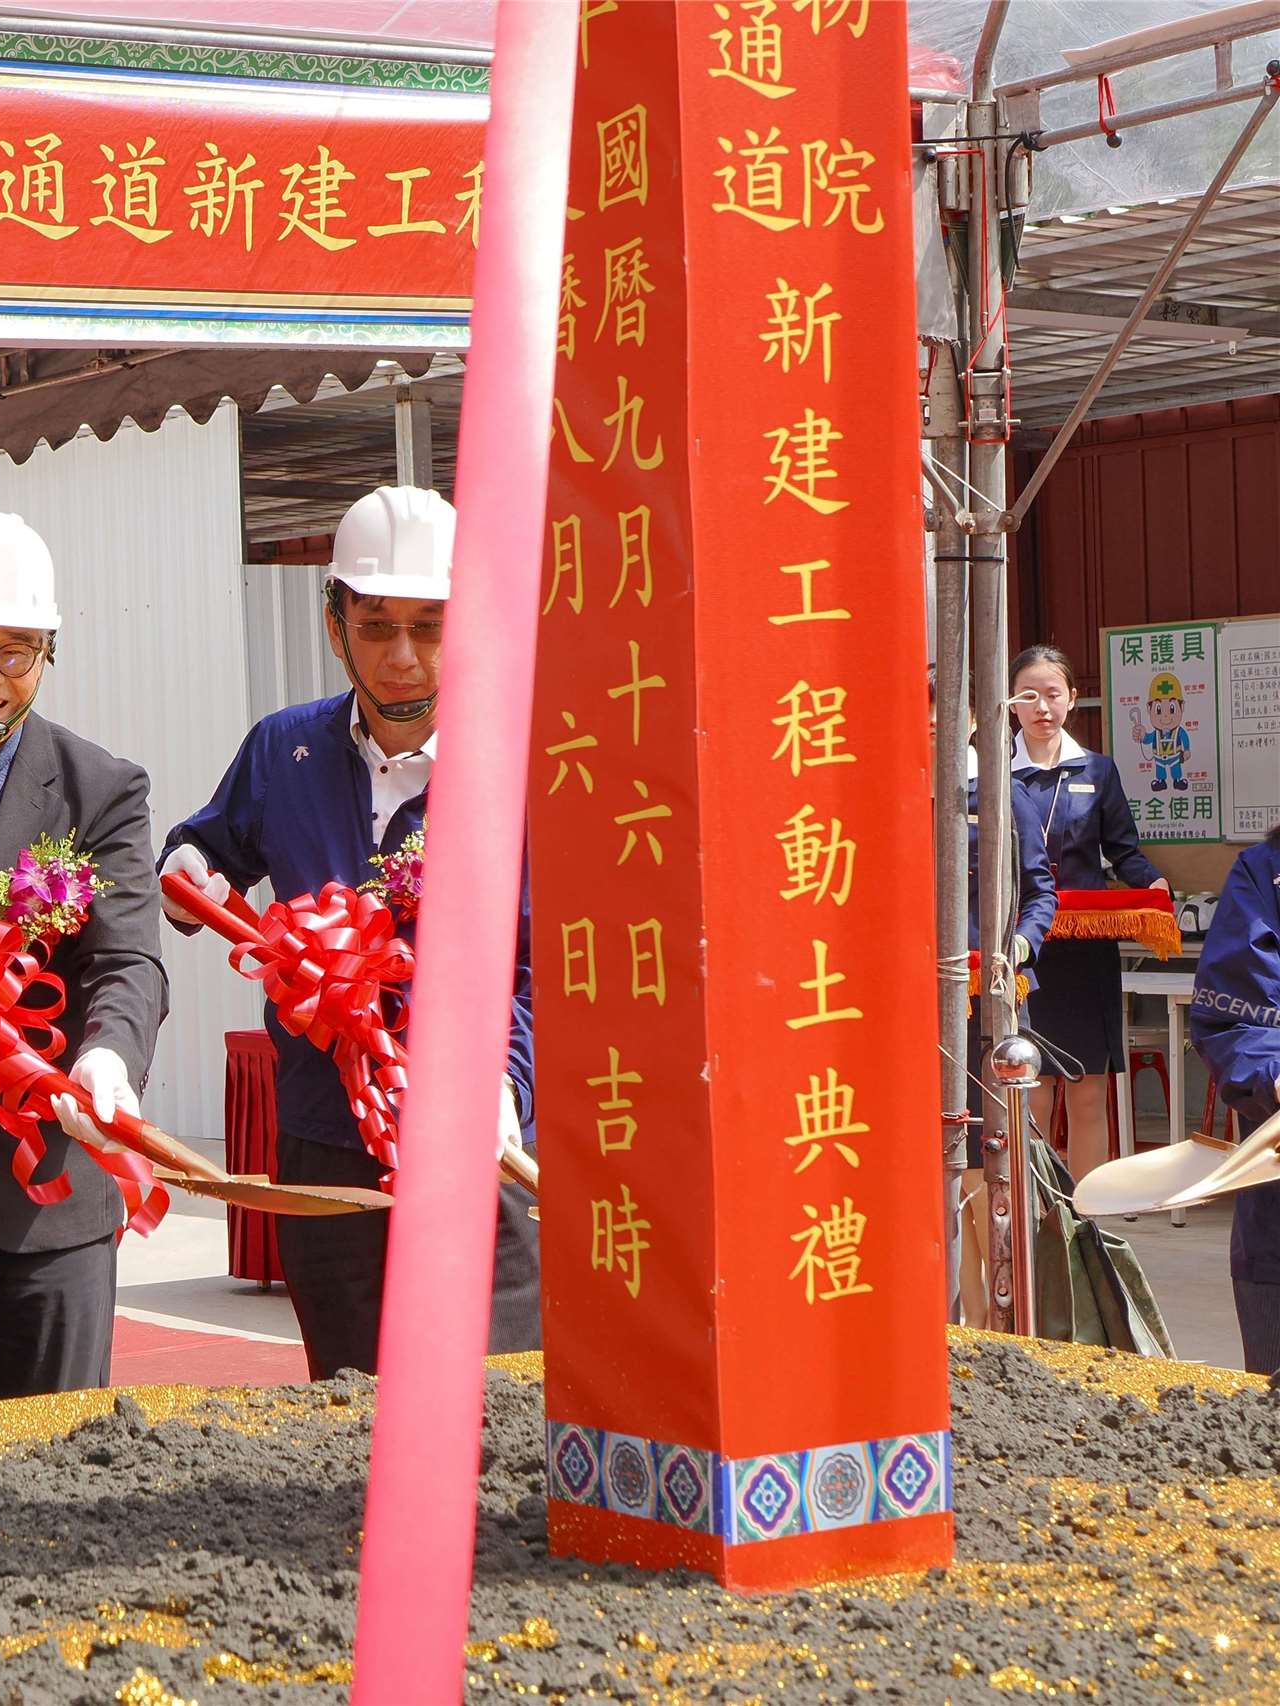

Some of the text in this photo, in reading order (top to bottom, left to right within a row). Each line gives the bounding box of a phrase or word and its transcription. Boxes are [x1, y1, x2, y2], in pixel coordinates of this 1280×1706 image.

[708, 0, 801, 232] 通道
[594, 103, 673, 1006] 國曆九月十六日
[1120, 631, 1205, 666] 保護具
[757, 276, 874, 1305] 新建工程動土典禮
[586, 1046, 652, 1298] 吉時
